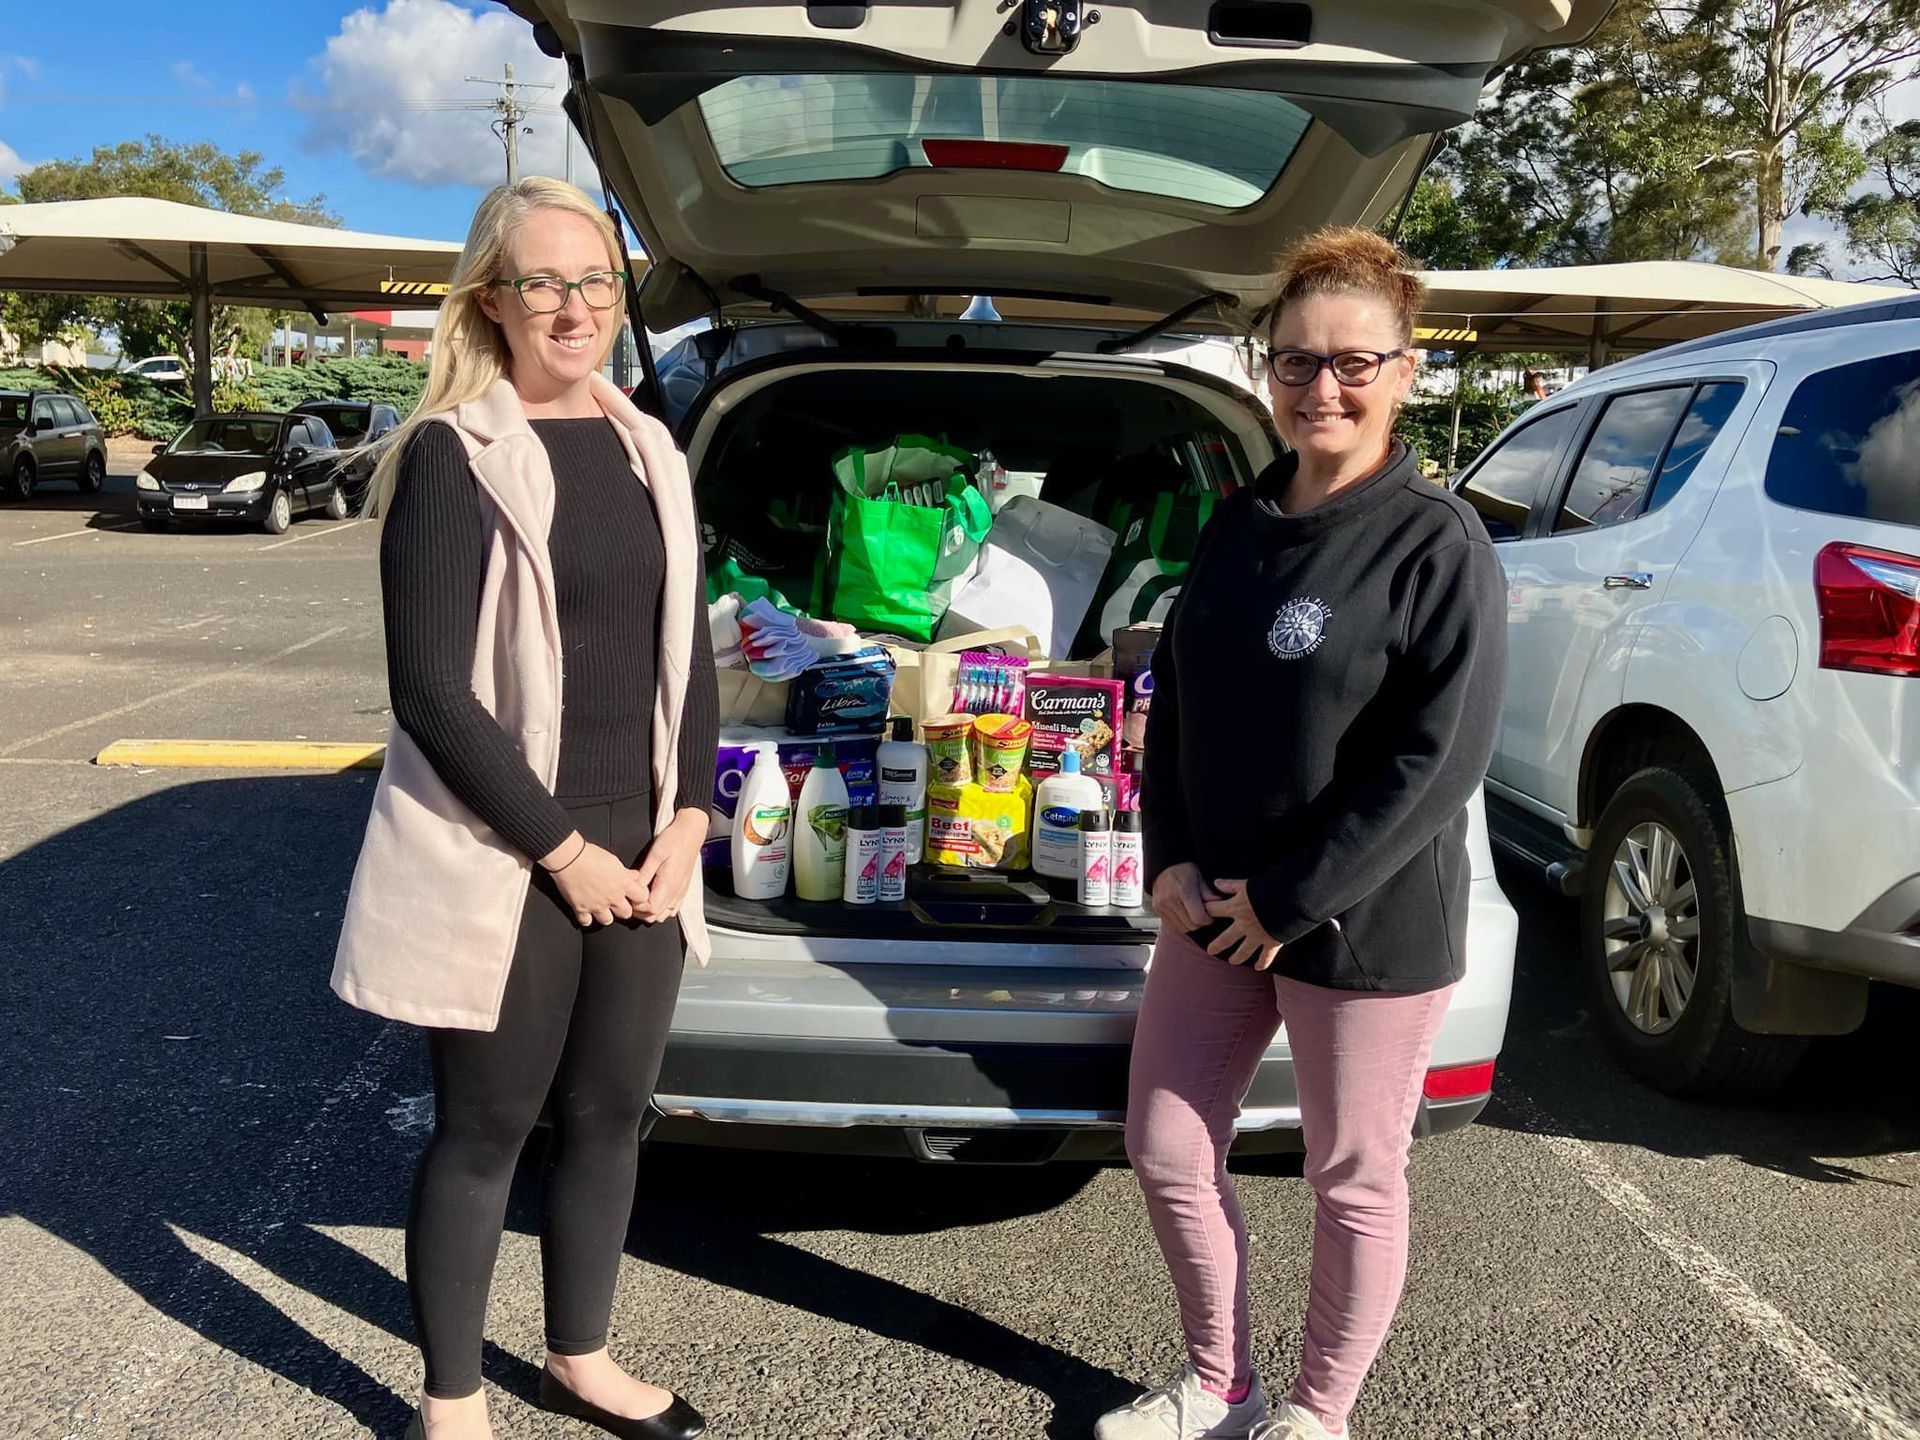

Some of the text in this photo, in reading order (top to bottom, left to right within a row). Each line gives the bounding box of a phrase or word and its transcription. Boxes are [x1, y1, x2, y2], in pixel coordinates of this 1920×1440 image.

[820, 697, 867, 711] Libra
[1030, 689, 1106, 710] Carman's
[1031, 720, 1060, 732] Muesli
[1060, 724, 1080, 733] Bars
[931, 817, 970, 831] Beef
[882, 836, 905, 844] LYNX
[1113, 841, 1137, 849] LYNX
